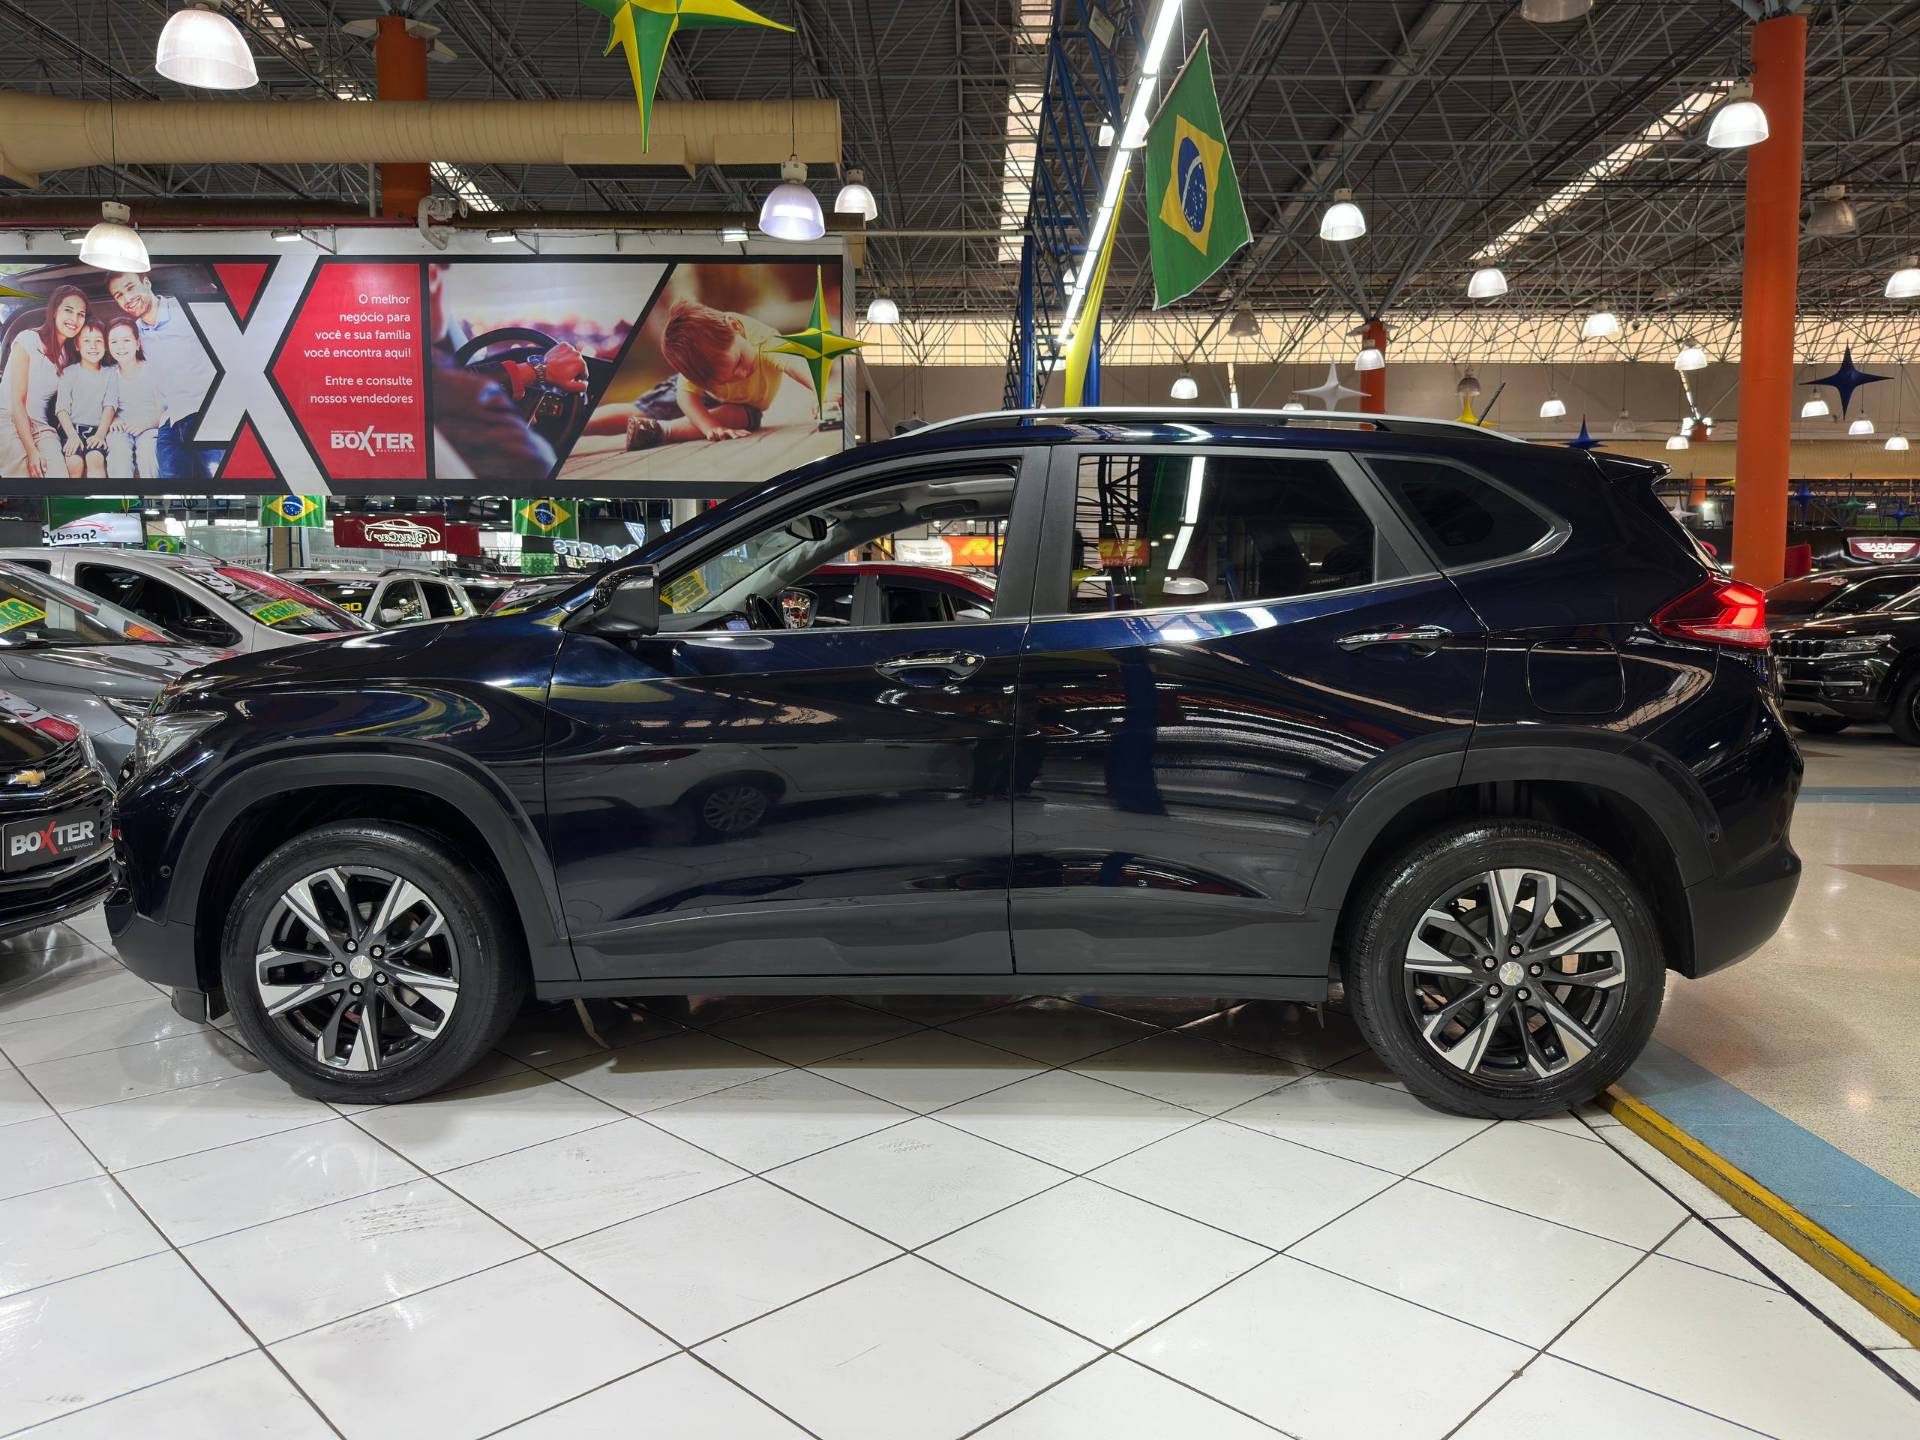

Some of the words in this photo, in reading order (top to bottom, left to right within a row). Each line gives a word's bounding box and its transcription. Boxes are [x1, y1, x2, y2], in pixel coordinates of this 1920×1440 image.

[358, 294, 368, 305] O
[371, 294, 410, 305] melhor
[339, 312, 384, 324] negócio
[387, 314, 411, 324] para
[315, 329, 341, 340] você
[344, 332, 351, 340] e
[353, 332, 372, 340] sua
[375, 328, 411, 340] família
[304, 347, 330, 358] você
[333, 349, 382, 358] encontra
[384, 347, 411, 360] aqui!
[325, 375, 354, 386] Entre
[357, 378, 363, 386] e
[366, 375, 413, 386] consulte
[310, 395, 347, 404] nossos
[350, 393, 413, 404] vendedores
[331, 425, 415, 456] BOXTER
[11, 820, 95, 857] BOXTER
